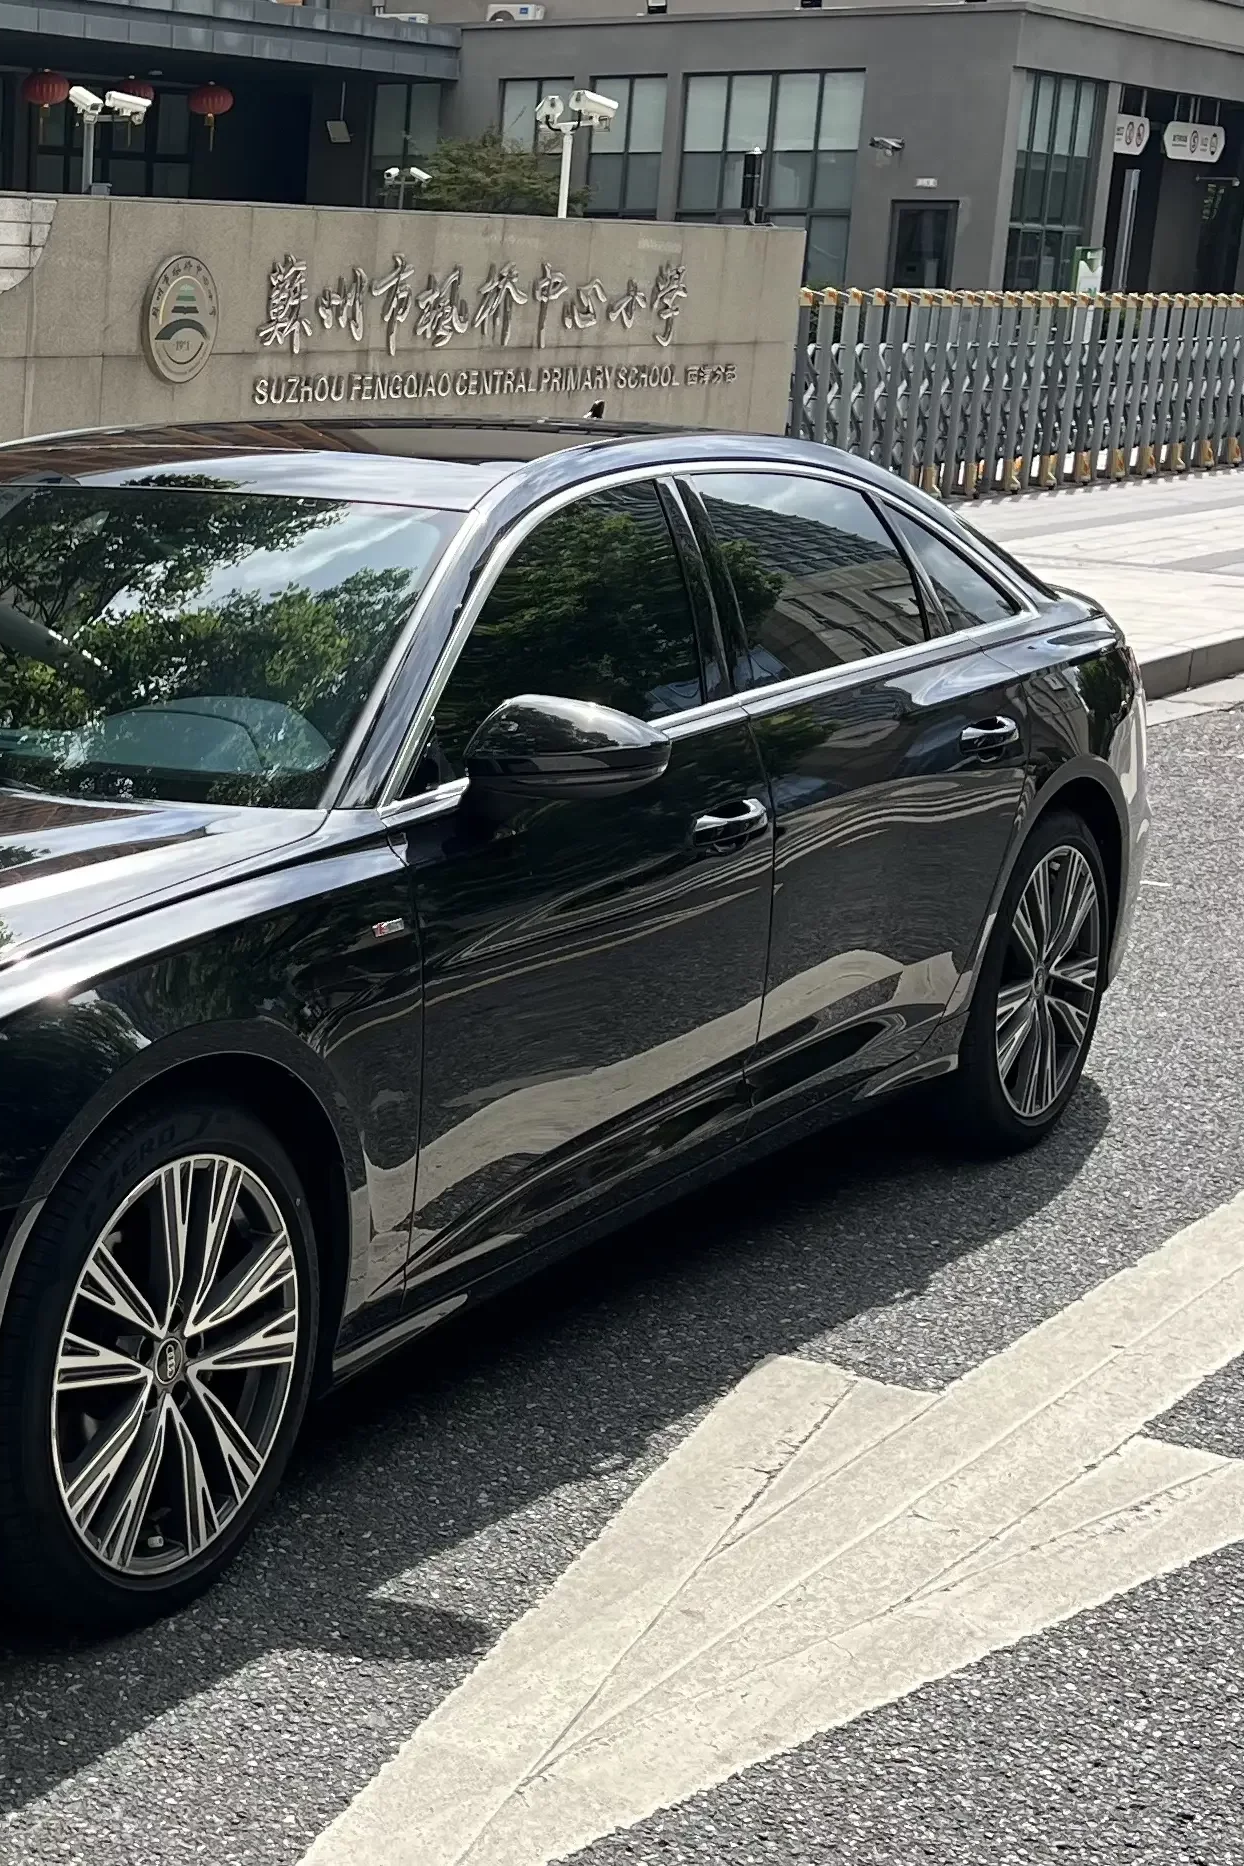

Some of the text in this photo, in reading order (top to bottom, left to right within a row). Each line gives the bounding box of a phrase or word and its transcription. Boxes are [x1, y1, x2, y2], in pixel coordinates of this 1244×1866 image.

[253, 374, 346, 405] SUZHOU
[348, 369, 452, 401] FENGQIAO
[454, 366, 537, 397] CENTRAL
[538, 364, 613, 393] PRIMARY
[615, 362, 680, 390] SCHOOL
